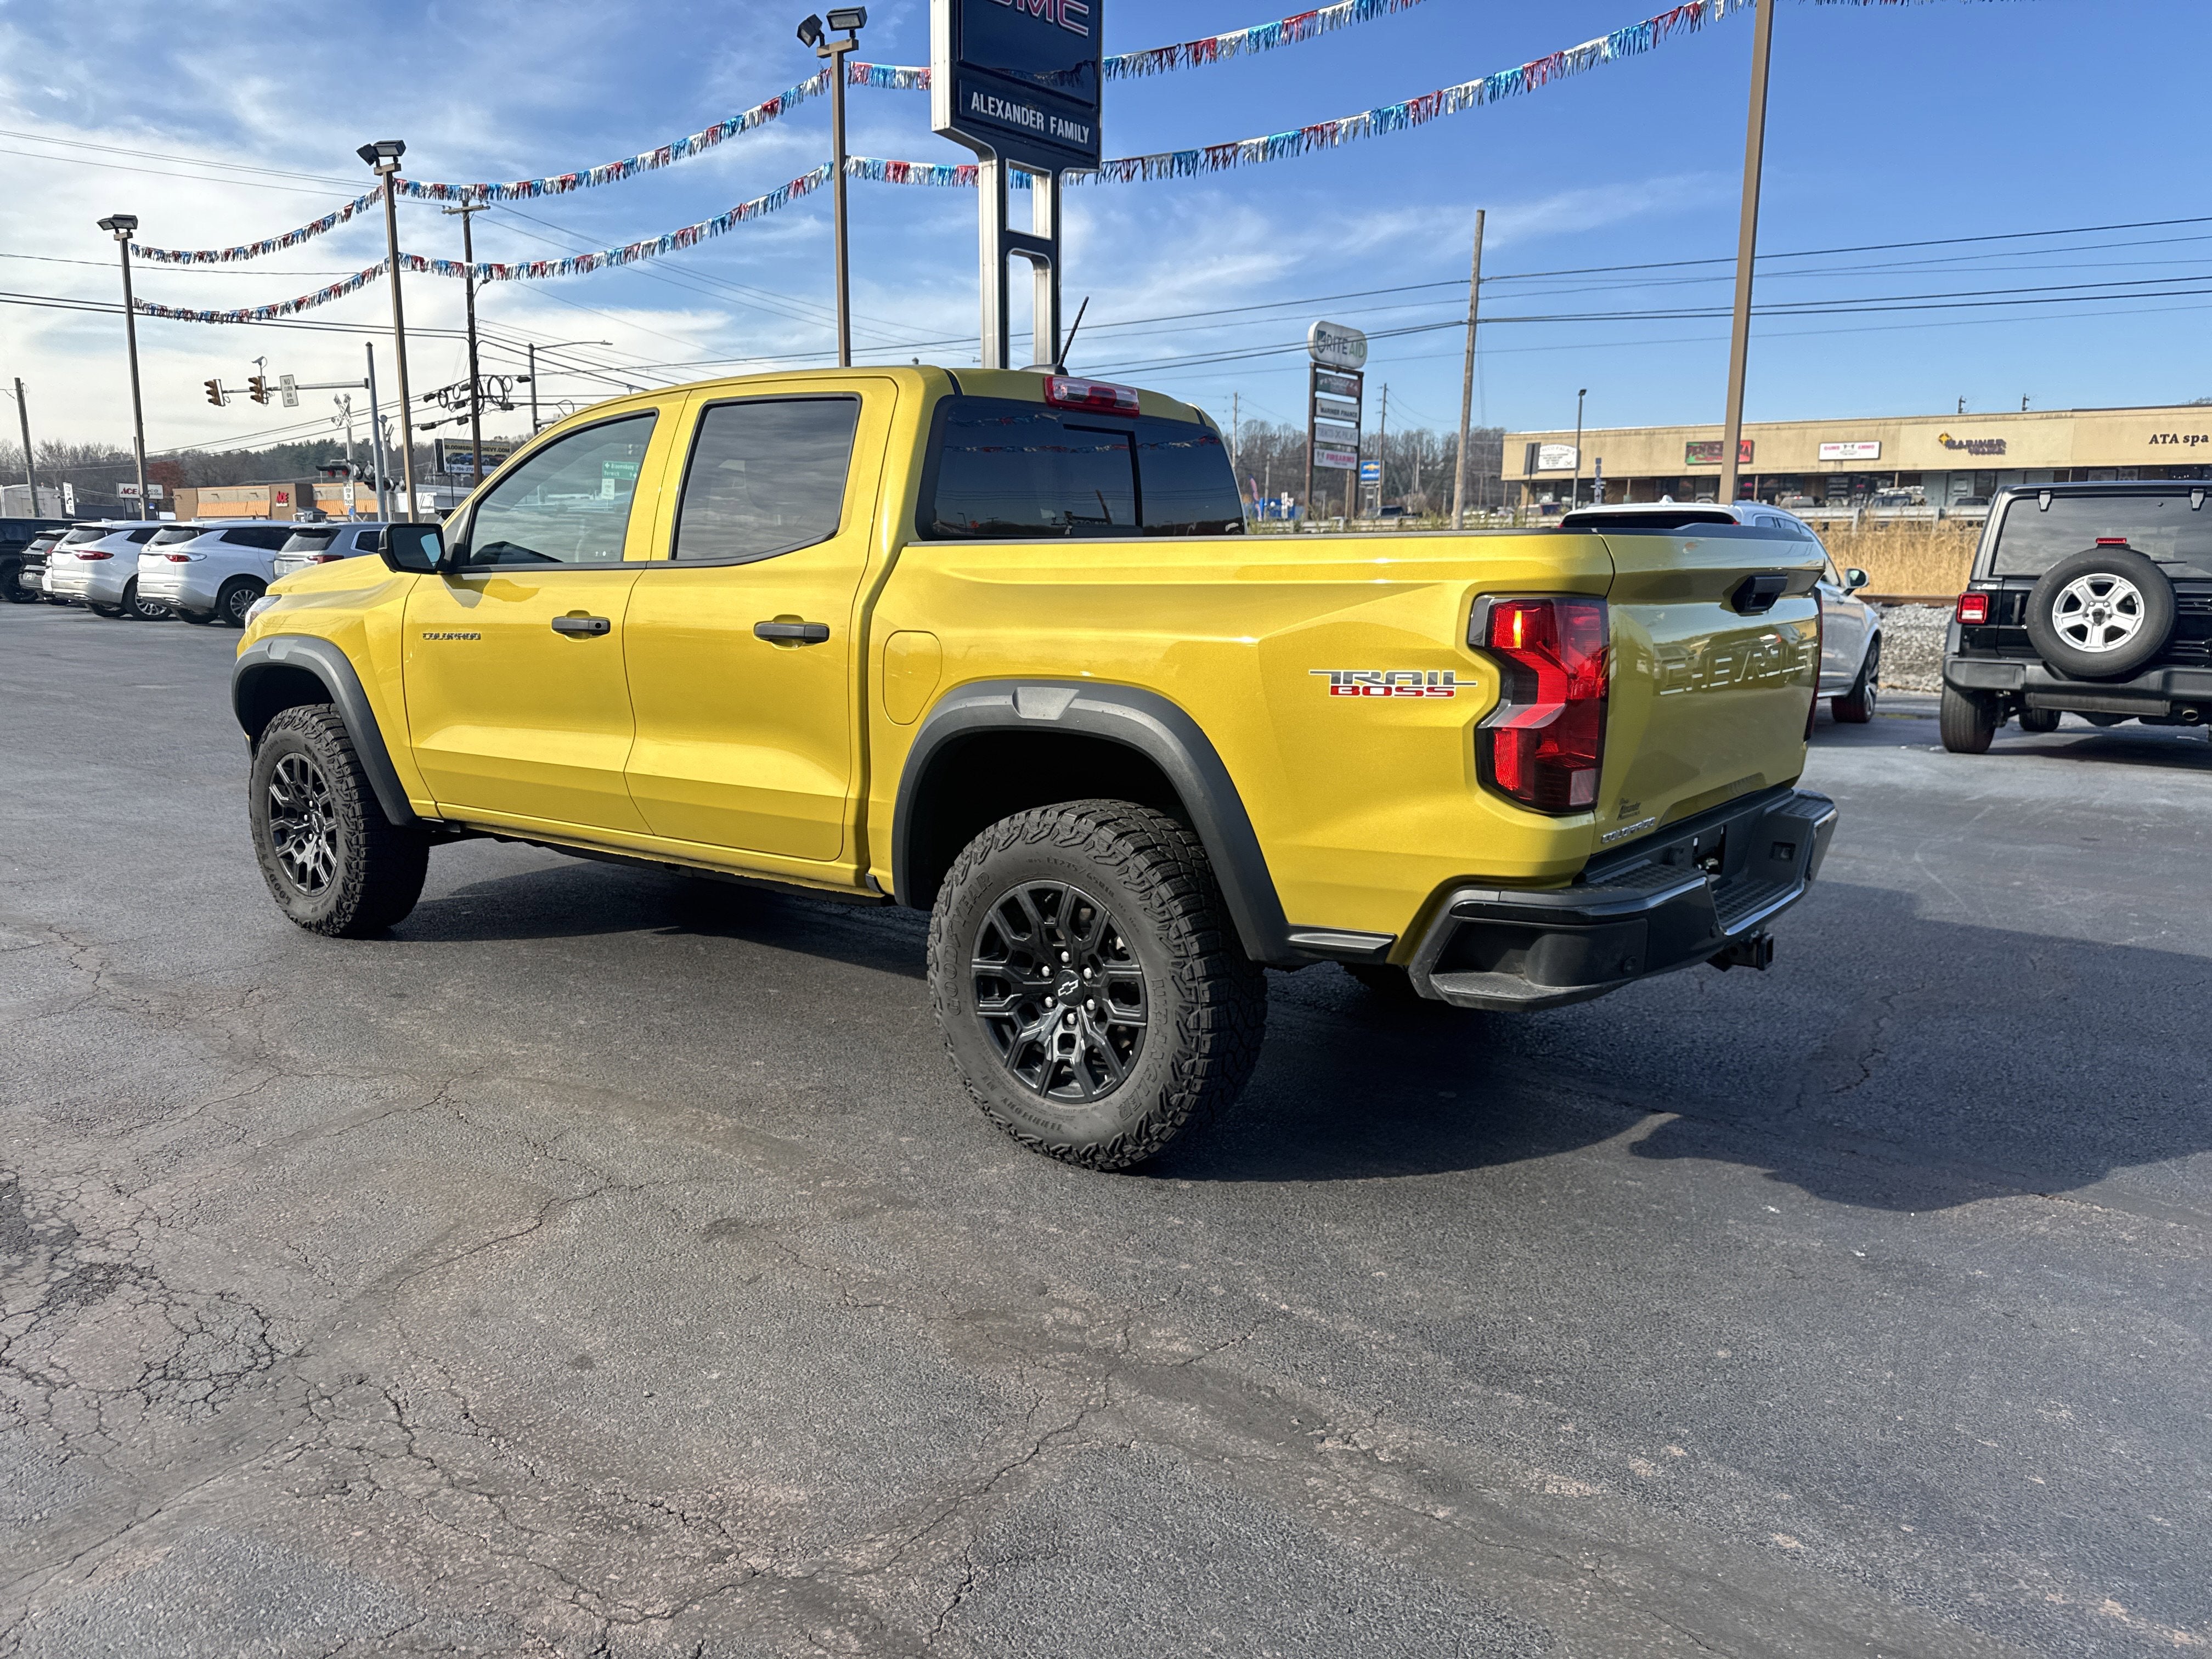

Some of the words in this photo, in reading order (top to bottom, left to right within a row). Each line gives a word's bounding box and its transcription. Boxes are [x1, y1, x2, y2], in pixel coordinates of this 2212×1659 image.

[994, 0, 1089, 37] MC
[971, 92, 1045, 132] ALEXANDER
[1050, 116, 1090, 144] FAMILY
[1327, 334, 1348, 355] RITE
[1349, 341, 1365, 358] AID
[2148, 433, 2180, 445] ATA
[2182, 434, 2209, 447] spa
[120, 487, 138, 495] ACE
[276, 491, 288, 503] ACE
[1309, 669, 1478, 686] TRAIL
[1329, 685, 1455, 699] BOSS
